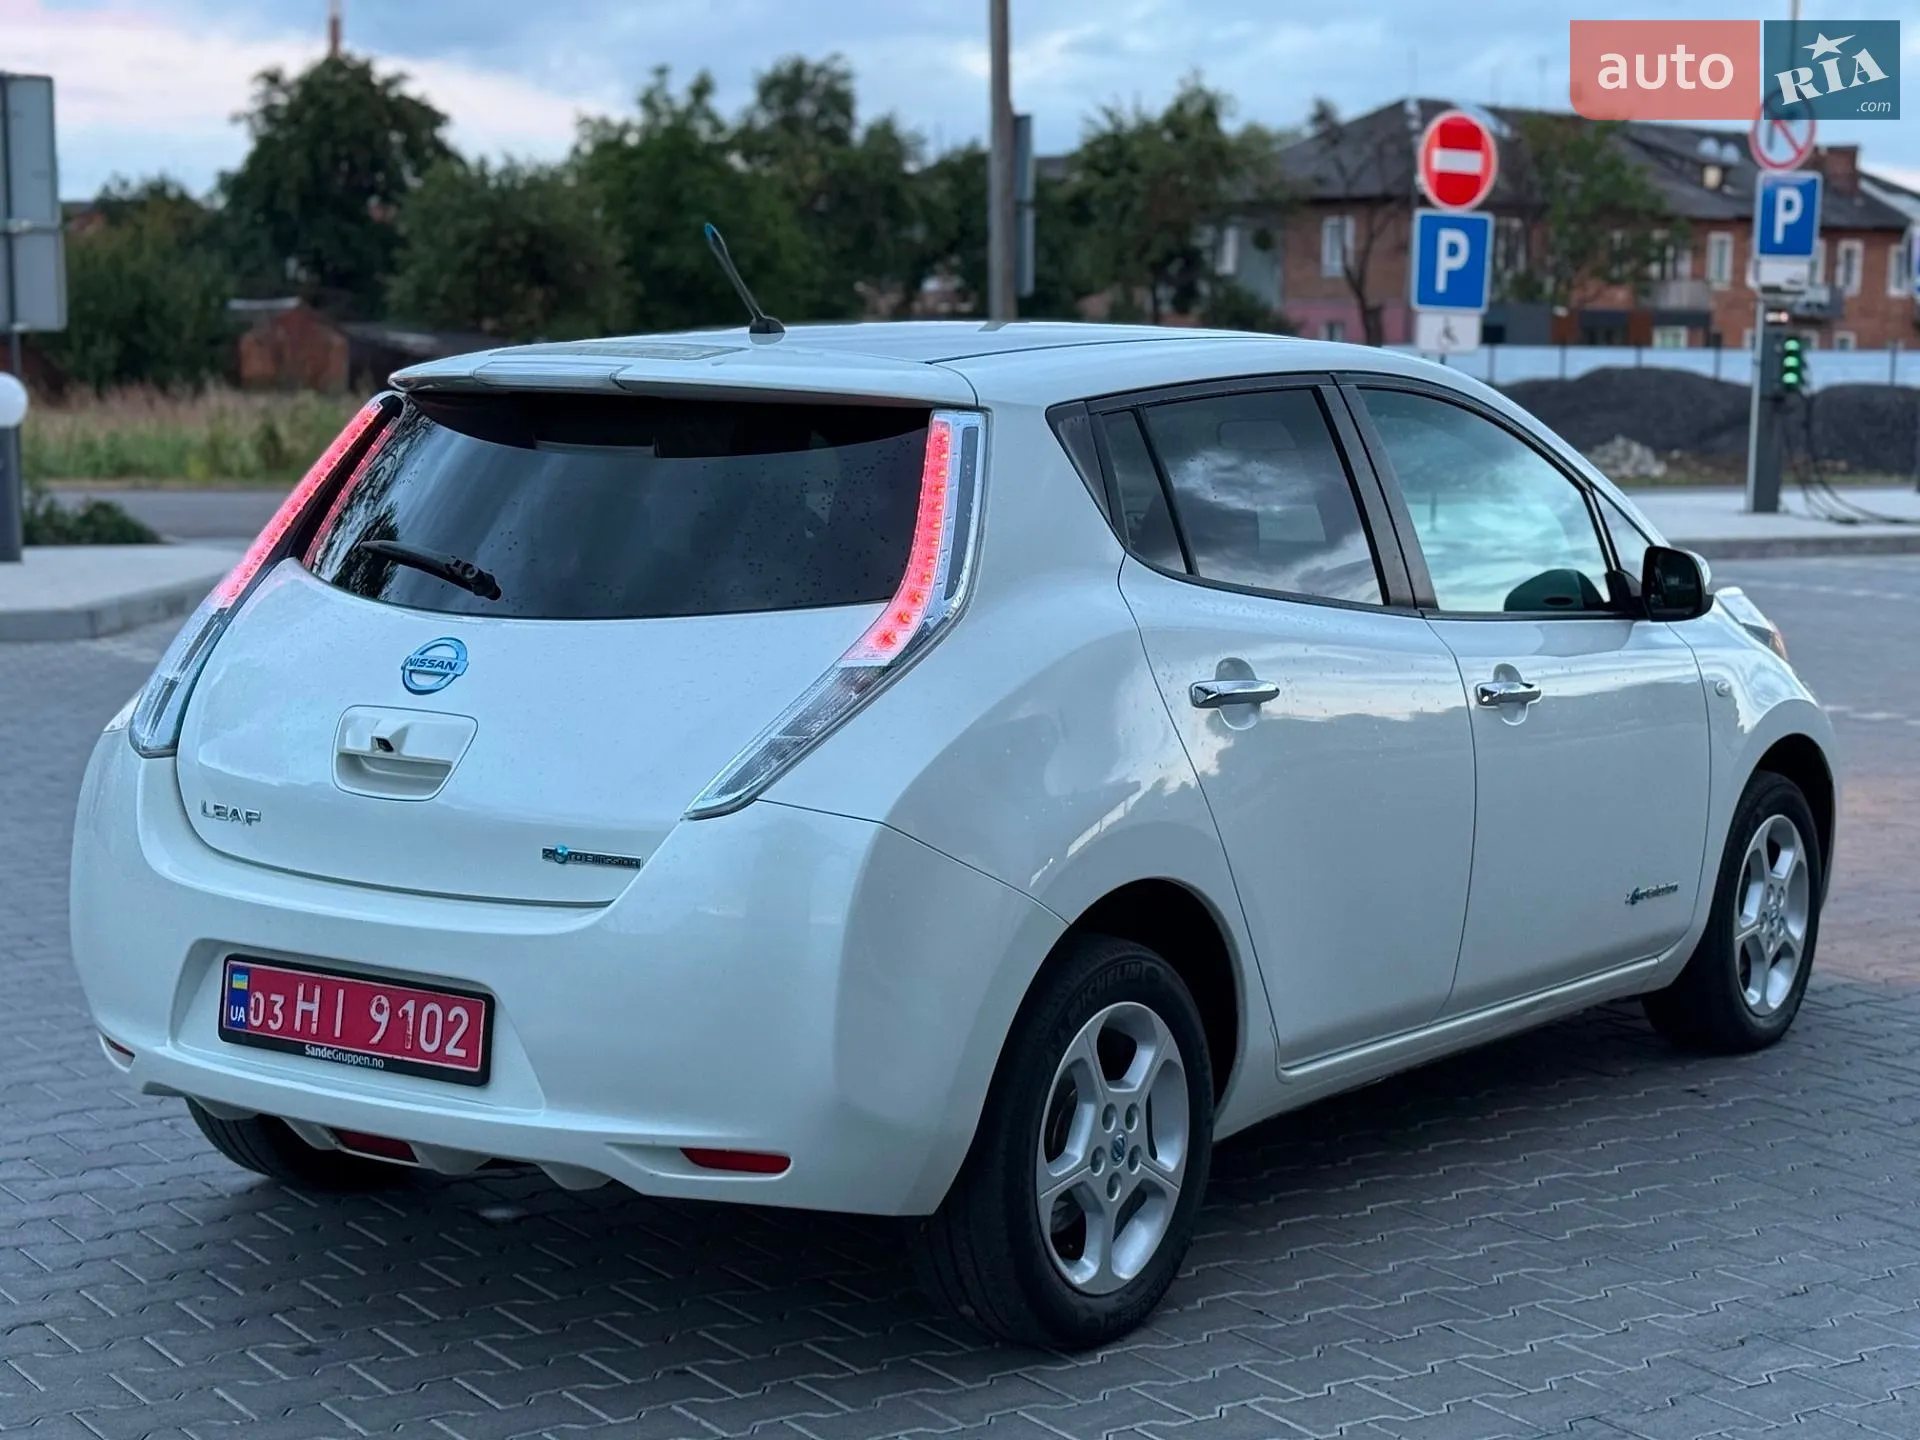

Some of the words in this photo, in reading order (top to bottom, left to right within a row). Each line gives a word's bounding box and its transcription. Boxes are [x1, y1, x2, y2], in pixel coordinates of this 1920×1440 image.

[1772, 187, 1804, 245] P
[1435, 228, 1470, 294] P
[409, 657, 458, 671] NISSAN
[201, 799, 262, 827] LEAF
[230, 1005, 246, 1023] UA
[249, 991, 285, 1031] 03
[369, 994, 470, 1058] 9102
[304, 1044, 385, 1069] SandeGruppen.no
